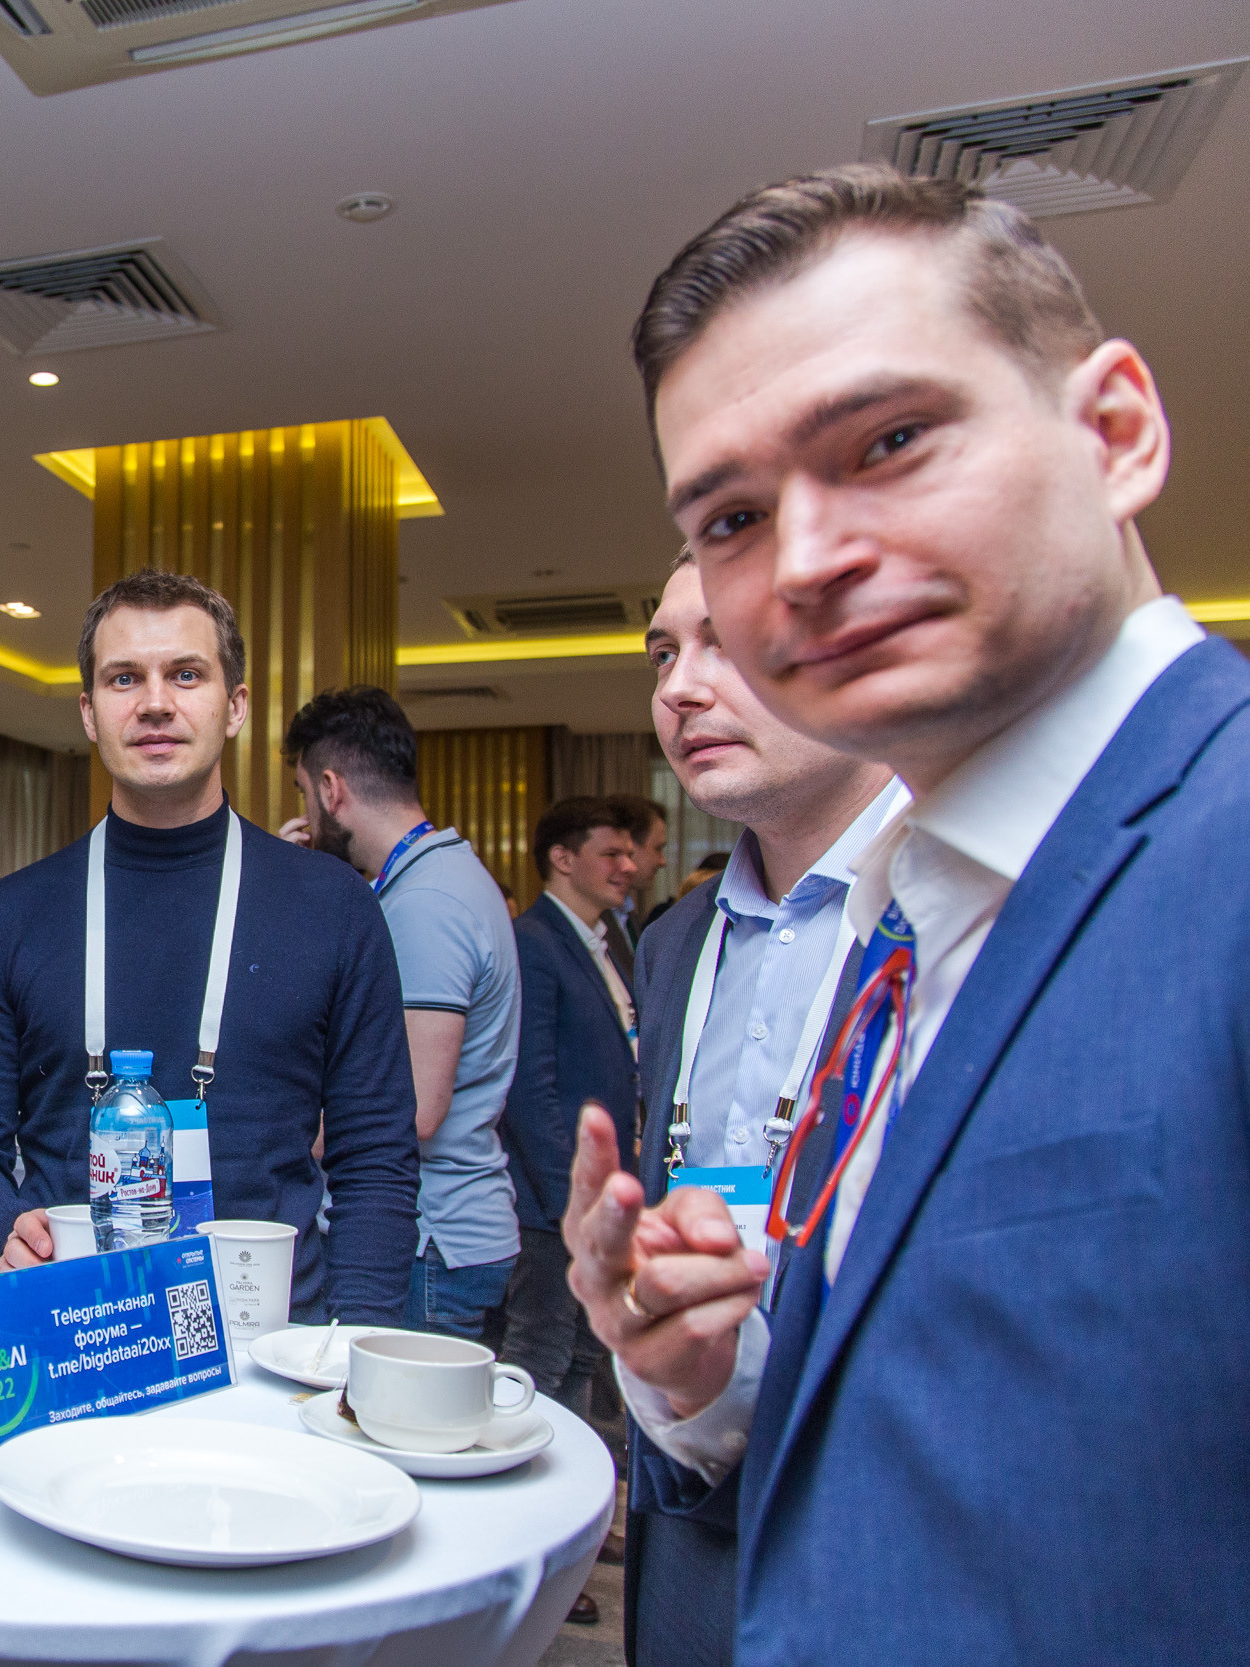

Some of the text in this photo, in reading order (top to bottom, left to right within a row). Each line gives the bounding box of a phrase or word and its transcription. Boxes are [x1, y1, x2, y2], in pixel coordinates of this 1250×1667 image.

[120, 1184, 157, 1197] Ростов-на-Дону
[229, 1284, 260, 1292] GARDEN
[51, 1293, 155, 1327] Telegram-канал
[74, 1323, 127, 1350] форума
[230, 1320, 260, 1328] PALMIRA
[48, 1336, 171, 1379] t.me/bigdataai20xx
[49, 1366, 222, 1423] Заходите, общайтесь, задавайте вопросы
